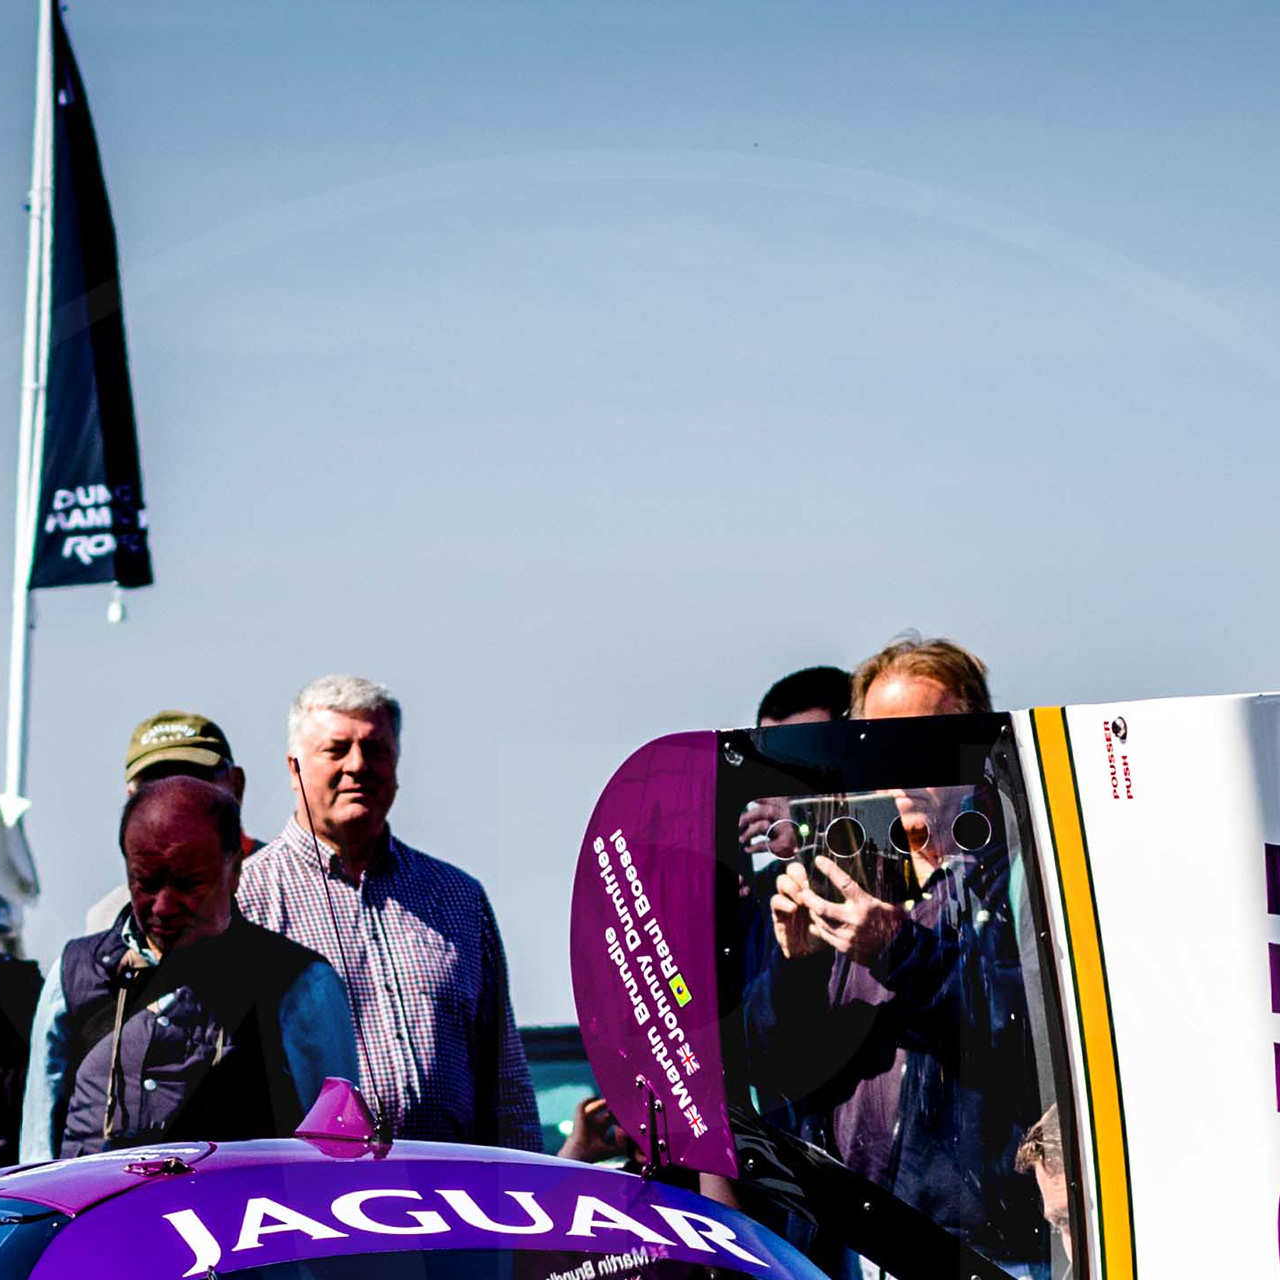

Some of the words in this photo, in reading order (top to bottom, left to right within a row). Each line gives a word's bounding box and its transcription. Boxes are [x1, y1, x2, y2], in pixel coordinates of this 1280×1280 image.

[1103, 720, 1120, 800] POUSSER
[1121, 755, 1134, 800] PUSH
[593, 836, 642, 953] Dumfries
[609, 828, 651, 918] Boesel
[605, 926, 651, 1026] Brundle
[643, 916, 679, 980] Raul
[636, 954, 685, 1043] Johnny
[646, 1025, 693, 1110] Martin
[162, 1188, 771, 1278] JAGUAR
